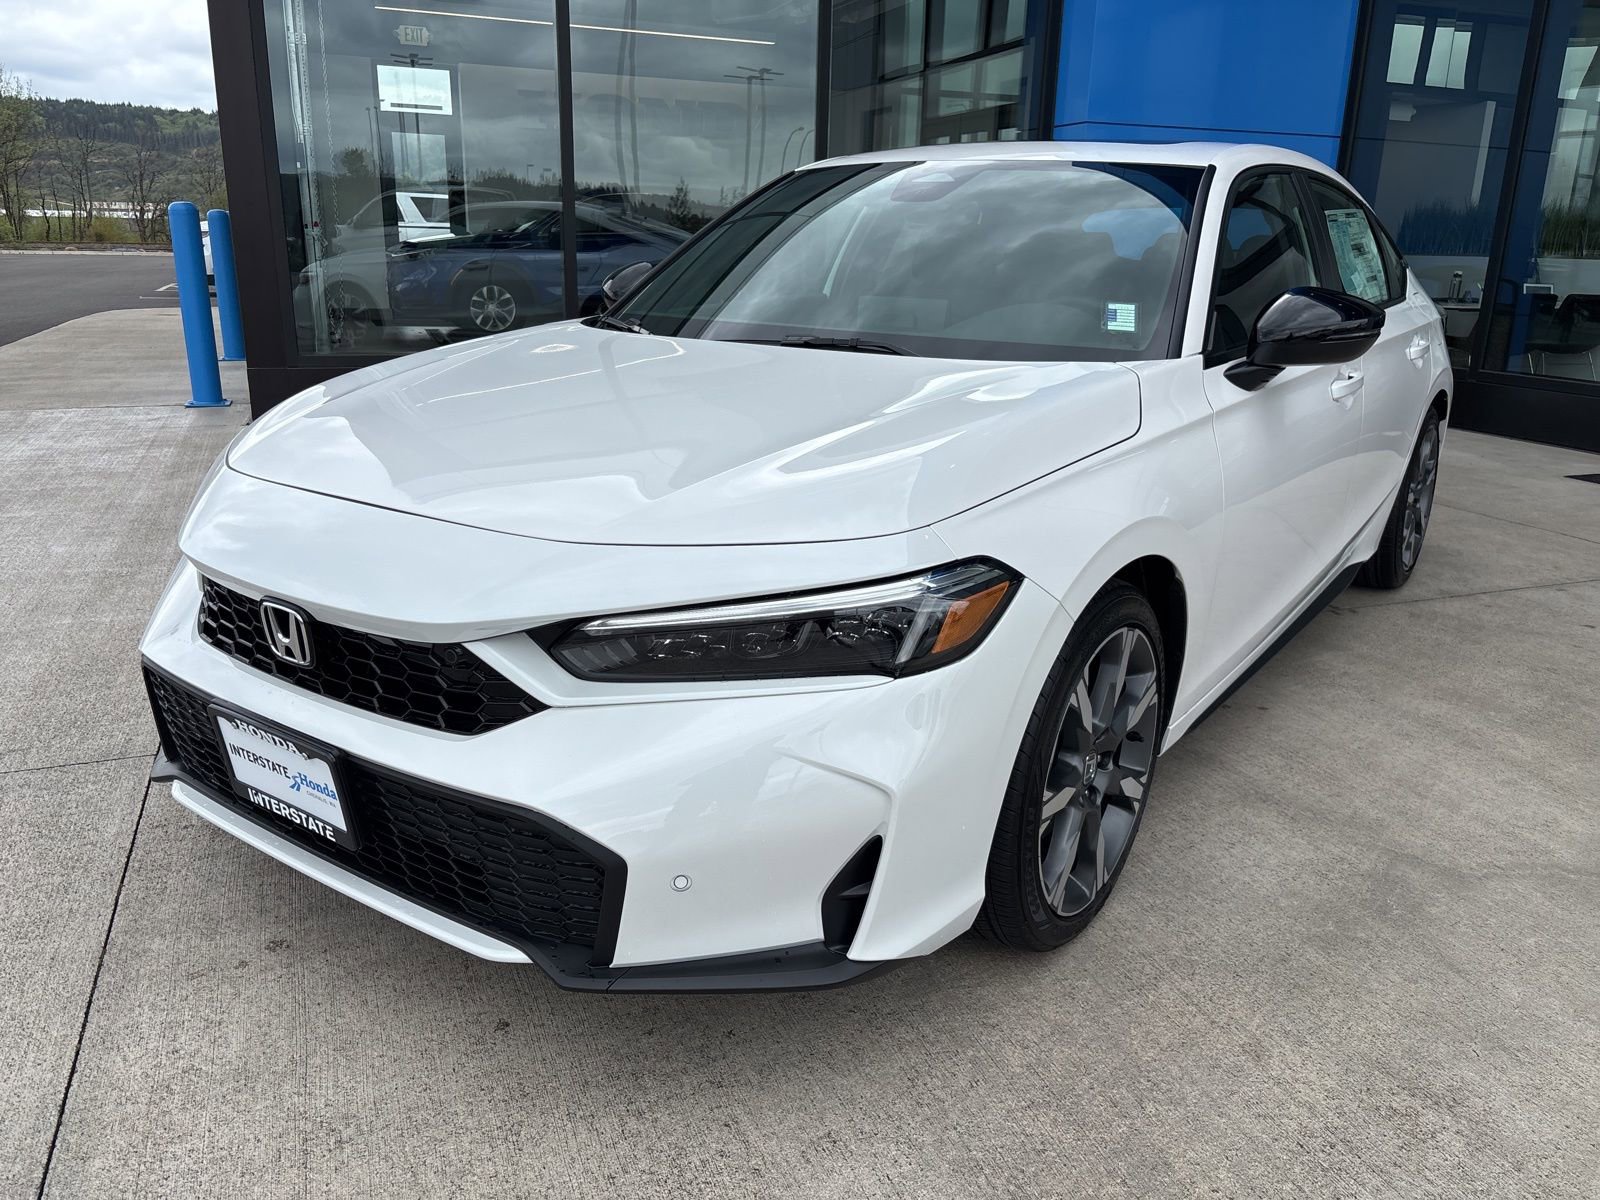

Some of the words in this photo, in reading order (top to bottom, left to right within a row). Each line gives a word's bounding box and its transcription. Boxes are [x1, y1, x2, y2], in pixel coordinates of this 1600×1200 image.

[404, 27, 424, 44] EXIT
[234, 719, 299, 754] HONDA
[229, 743, 291, 780] INTERSTATE
[298, 772, 337, 801] Honda
[247, 787, 336, 842] INTERSTATE
